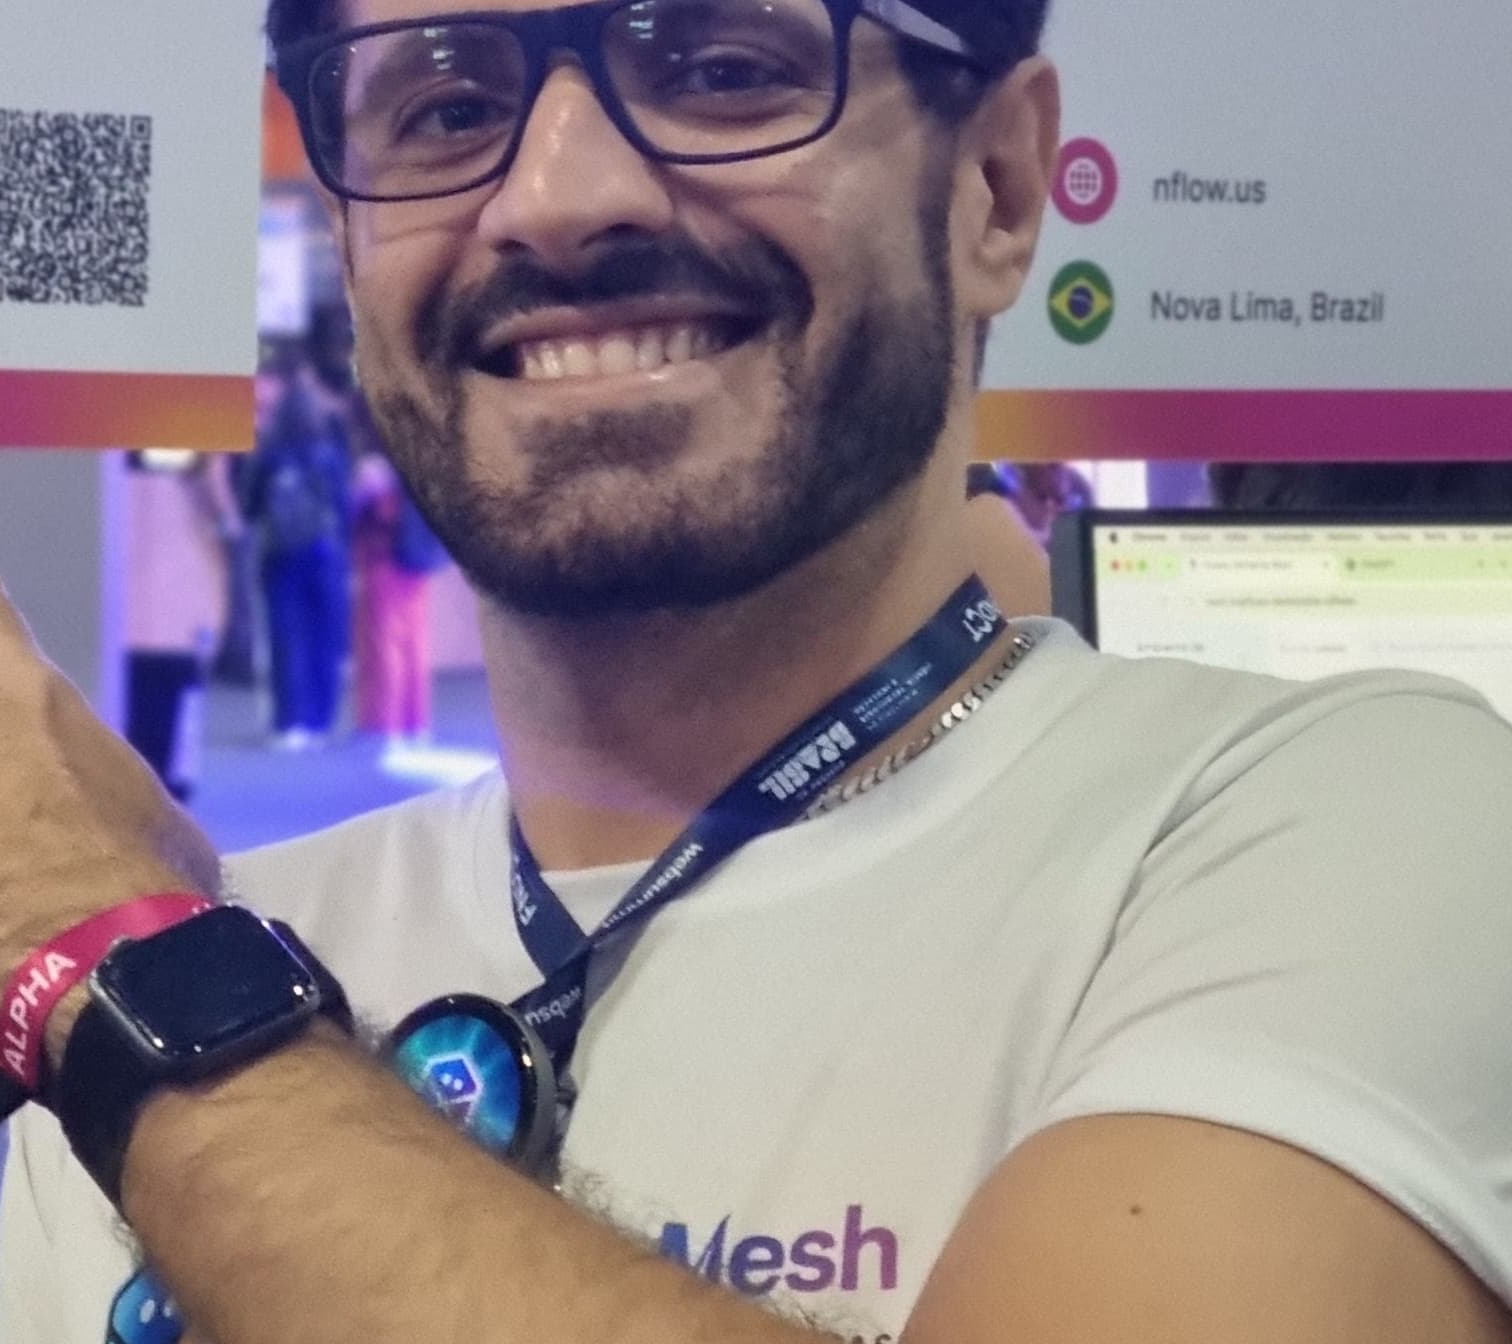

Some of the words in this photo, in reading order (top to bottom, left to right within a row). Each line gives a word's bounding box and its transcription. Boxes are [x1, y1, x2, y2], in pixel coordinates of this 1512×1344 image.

[1152, 170, 1267, 206] nflow.us
[1150, 291, 1222, 324] Nova
[1229, 291, 1303, 329] Lima,
[1310, 291, 1386, 324] Brazil
[758, 720, 857, 803] BRASIL
[3, 950, 77, 1076] ALPHA
